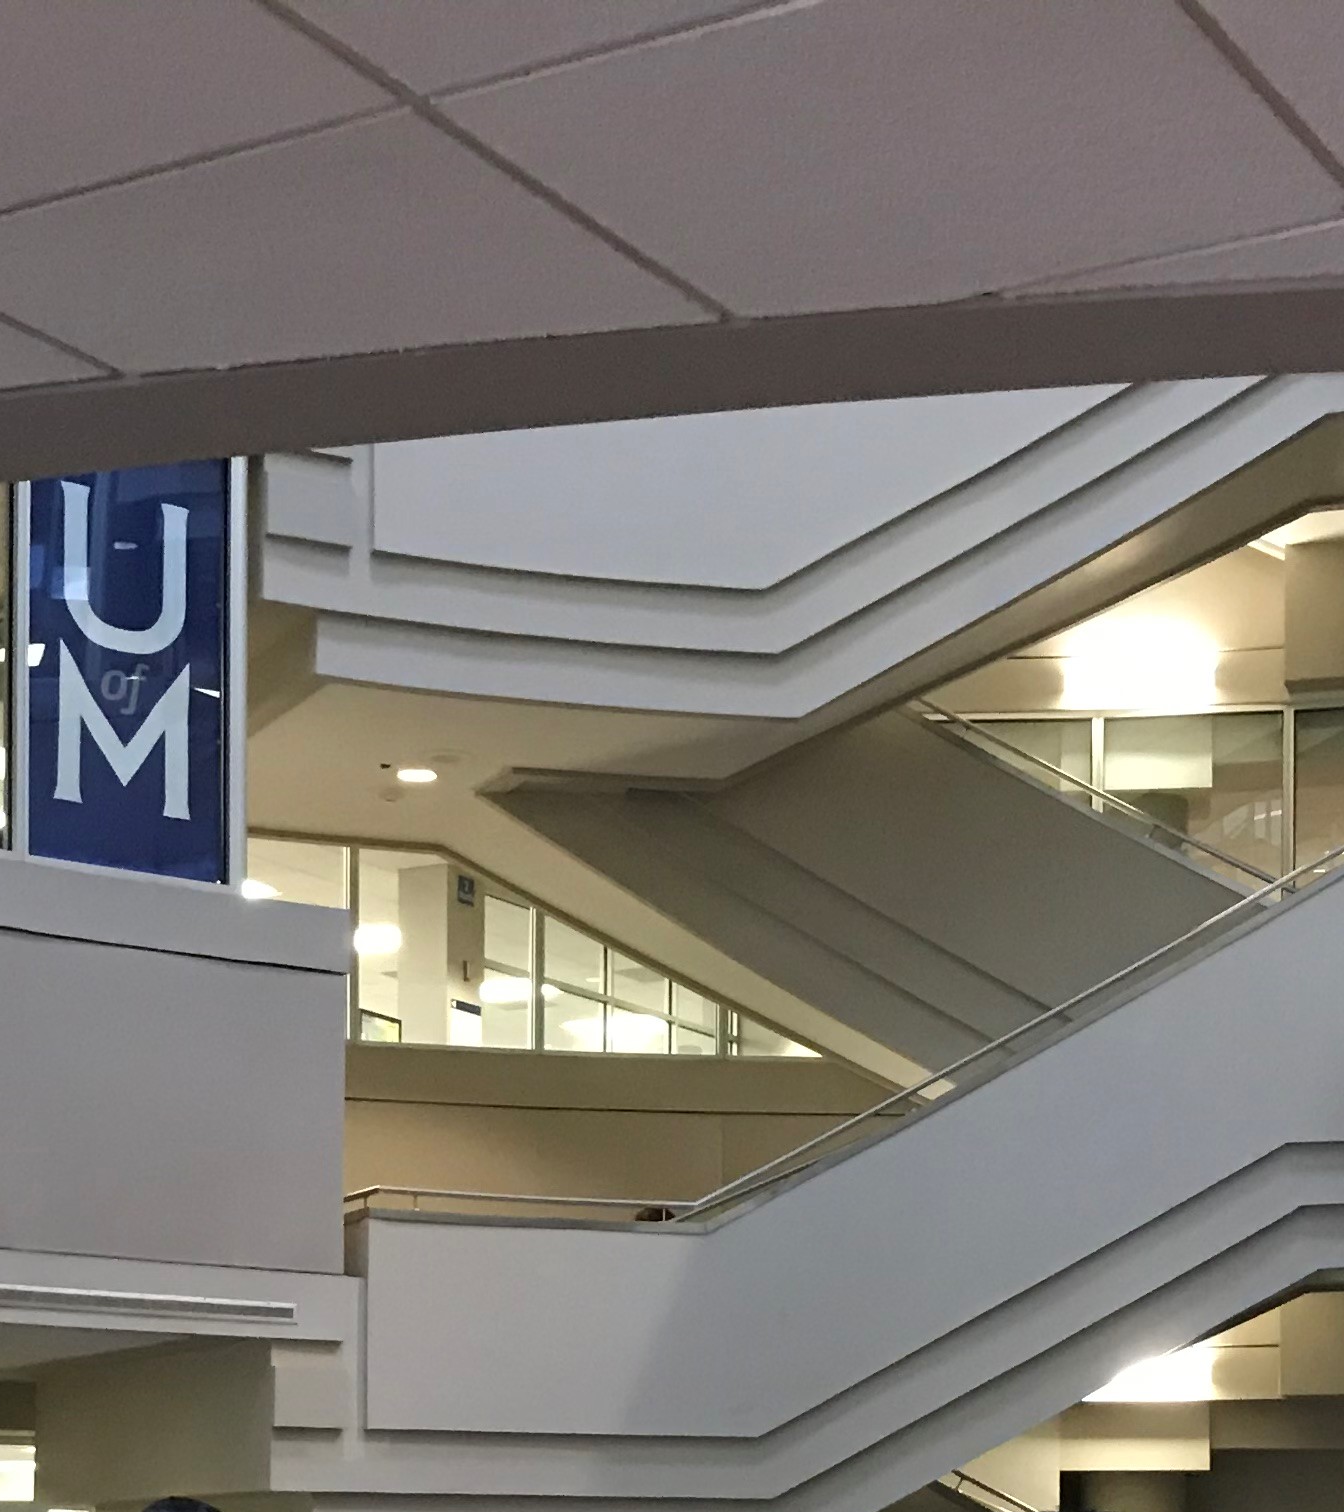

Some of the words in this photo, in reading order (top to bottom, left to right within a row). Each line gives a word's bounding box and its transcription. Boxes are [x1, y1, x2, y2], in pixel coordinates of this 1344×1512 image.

[59, 480, 190, 655] U
[53, 637, 191, 820] M
[100, 663, 150, 715] of
